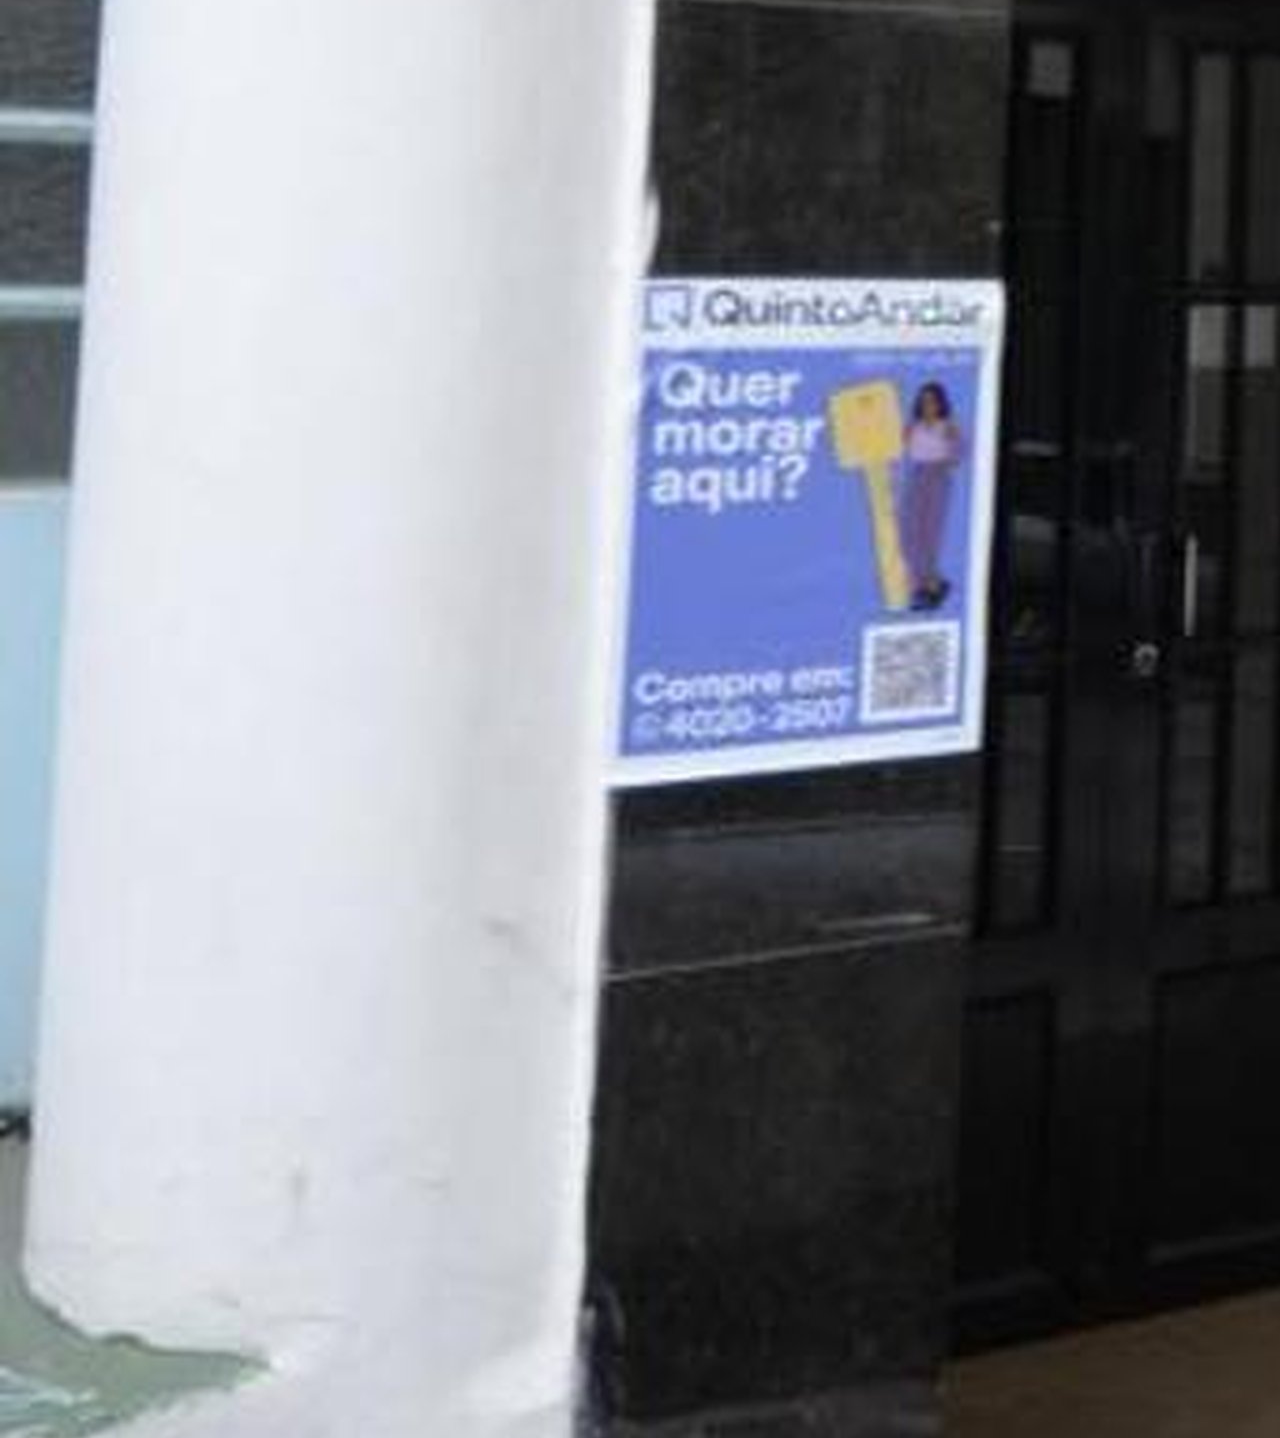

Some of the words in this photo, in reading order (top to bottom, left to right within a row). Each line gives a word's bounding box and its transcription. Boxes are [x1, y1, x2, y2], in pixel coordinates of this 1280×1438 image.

[703, 286, 984, 327] QuintoAndar
[660, 361, 802, 410] Quer
[654, 416, 825, 457] morar
[650, 453, 808, 514] aqui?
[633, 669, 785, 706] Compre
